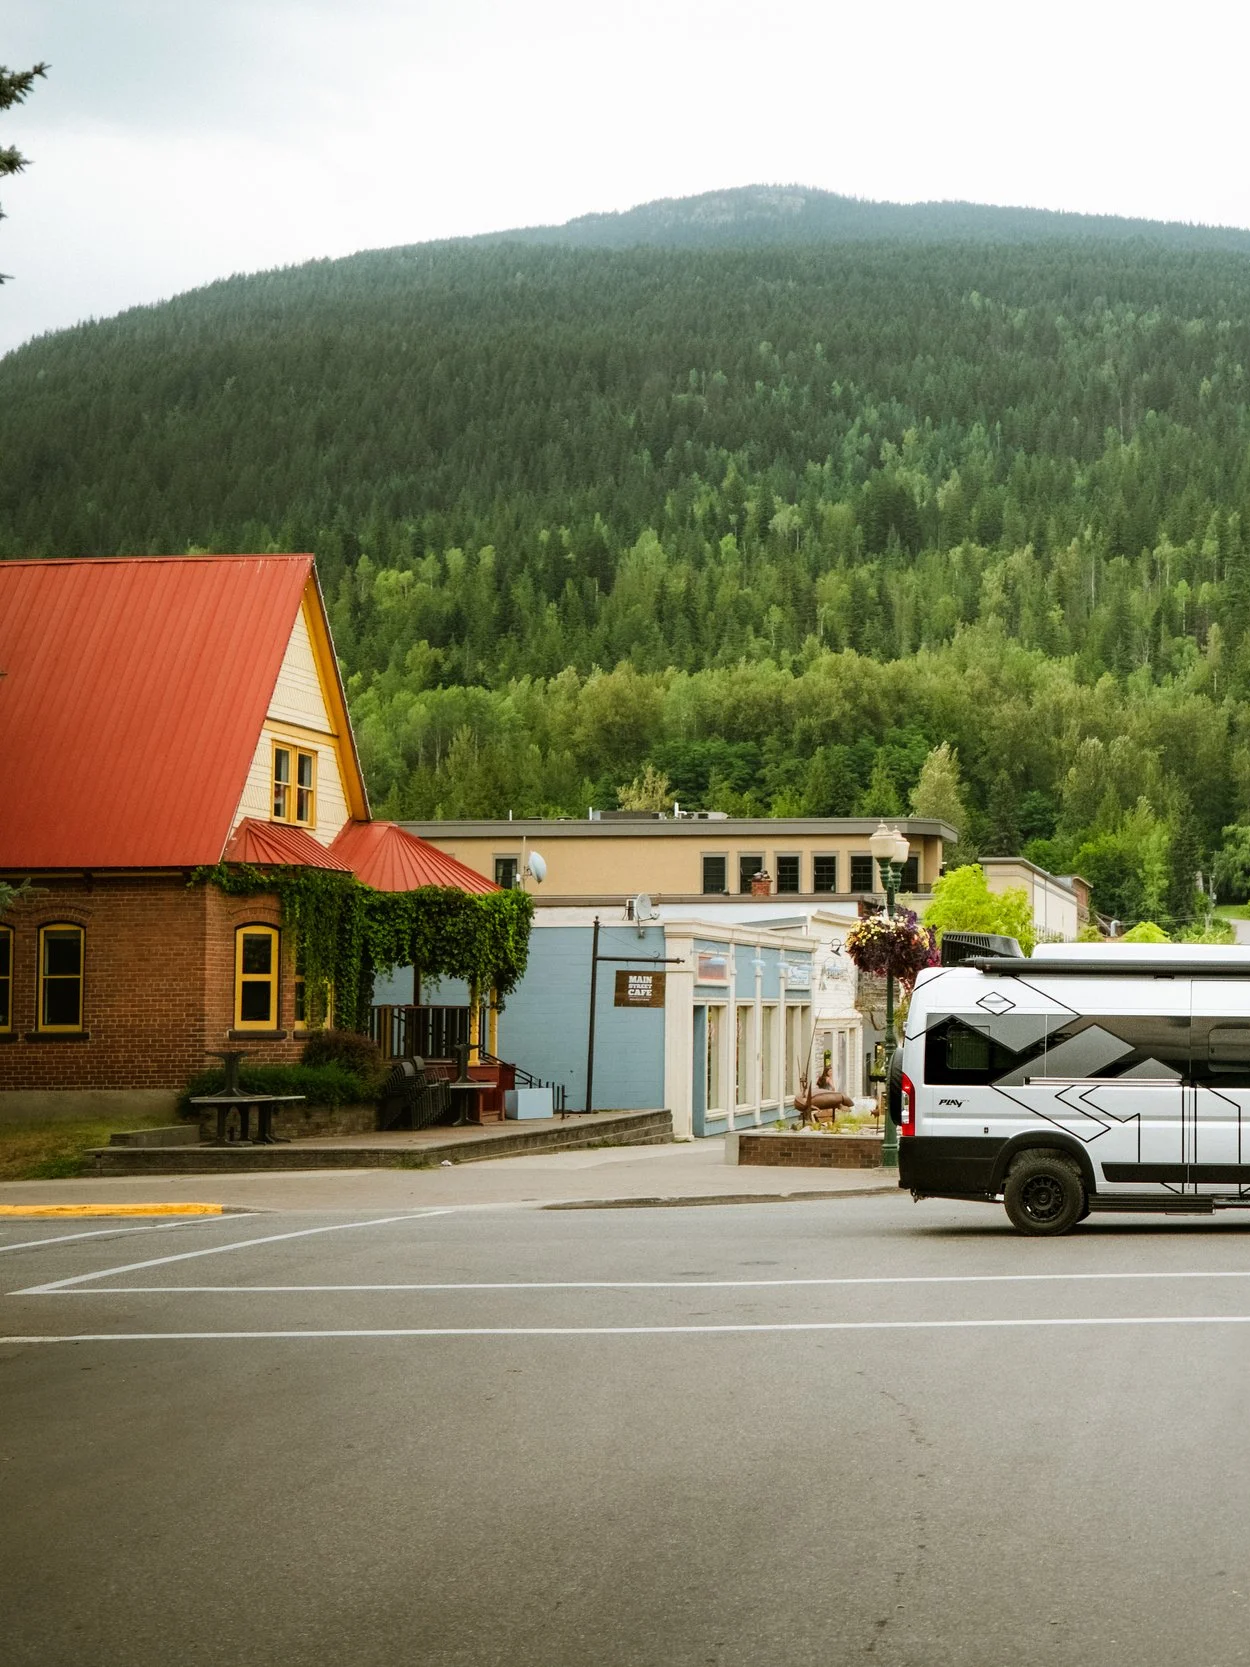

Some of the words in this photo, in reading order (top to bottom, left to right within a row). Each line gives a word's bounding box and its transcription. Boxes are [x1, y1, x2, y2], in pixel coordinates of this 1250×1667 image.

[628, 975, 653, 984] MAIN
[627, 989, 653, 997] CAFE
[938, 1098, 963, 1108] PLAY
